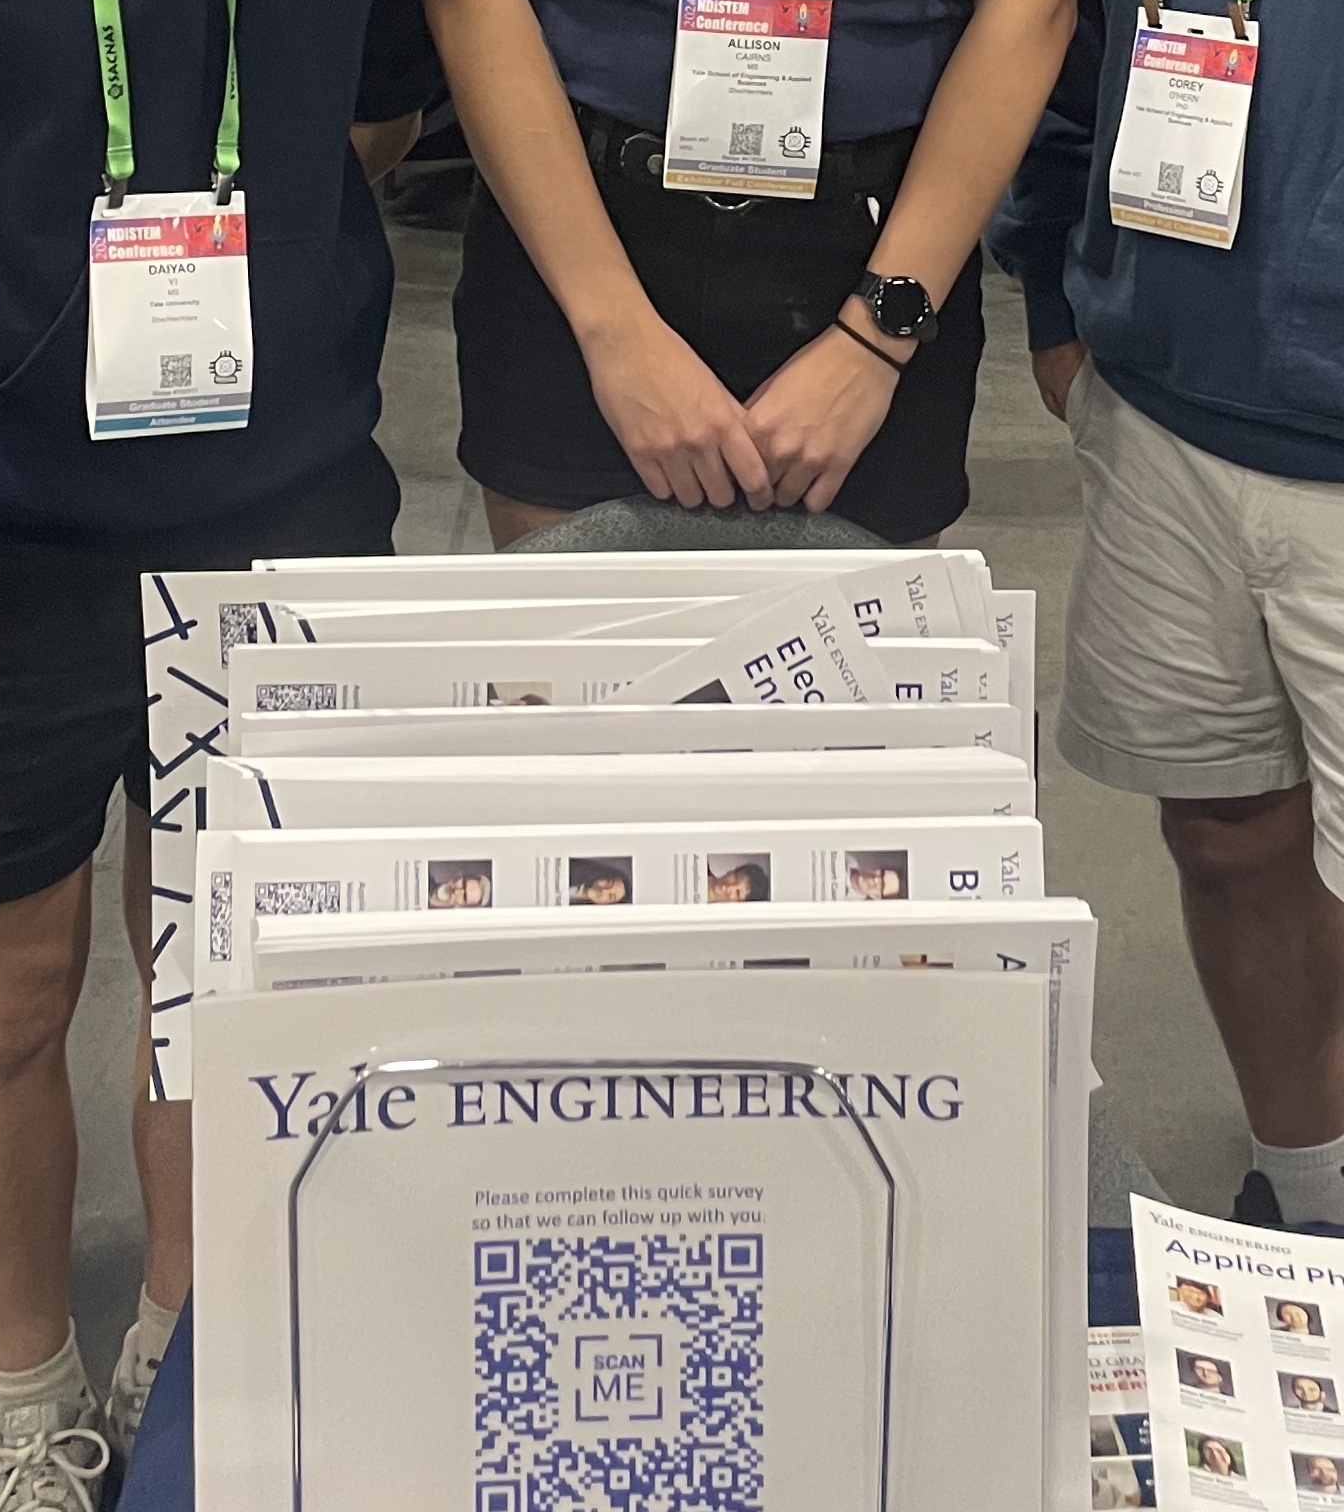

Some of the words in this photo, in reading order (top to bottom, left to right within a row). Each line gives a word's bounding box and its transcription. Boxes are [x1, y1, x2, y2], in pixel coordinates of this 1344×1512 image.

[696, 16, 770, 34] Conference
[103, 23, 123, 86] SACNAS
[727, 38, 781, 51] ALLISON
[1143, 54, 1201, 75] Conference
[1169, 77, 1205, 92] COREY
[698, 162, 746, 174] Graduate
[747, 165, 788, 177] Student
[108, 244, 184, 260] Conference
[148, 263, 196, 276] DAIYAO
[128, 401, 177, 412] Graduate
[178, 396, 221, 409] Student
[905, 573, 929, 612] Yale
[810, 604, 837, 647] Yale
[1000, 850, 1021, 897] Yale
[249, 1062, 417, 1141] Yale
[447, 1072, 965, 1128] ENGINEERING
[475, 1190, 530, 1206] Please
[535, 1186, 616, 1206] complete
[621, 1185, 652, 1201] this
[657, 1183, 703, 1203] quick
[708, 1185, 765, 1202] survey
[471, 1218, 492, 1231] so
[496, 1215, 531, 1229] that
[536, 1214, 561, 1228] we
[567, 1213, 597, 1227] can
[602, 1209, 655, 1225] follow
[659, 1210, 683, 1227] up
[687, 1208, 725, 1224] with
[1149, 1210, 1186, 1235] Yale
[1188, 1226, 1292, 1255] ENGINEERING
[1165, 1238, 1296, 1281] Applied
[593, 1354, 645, 1370] SCAN
[592, 1373, 645, 1402] ME
